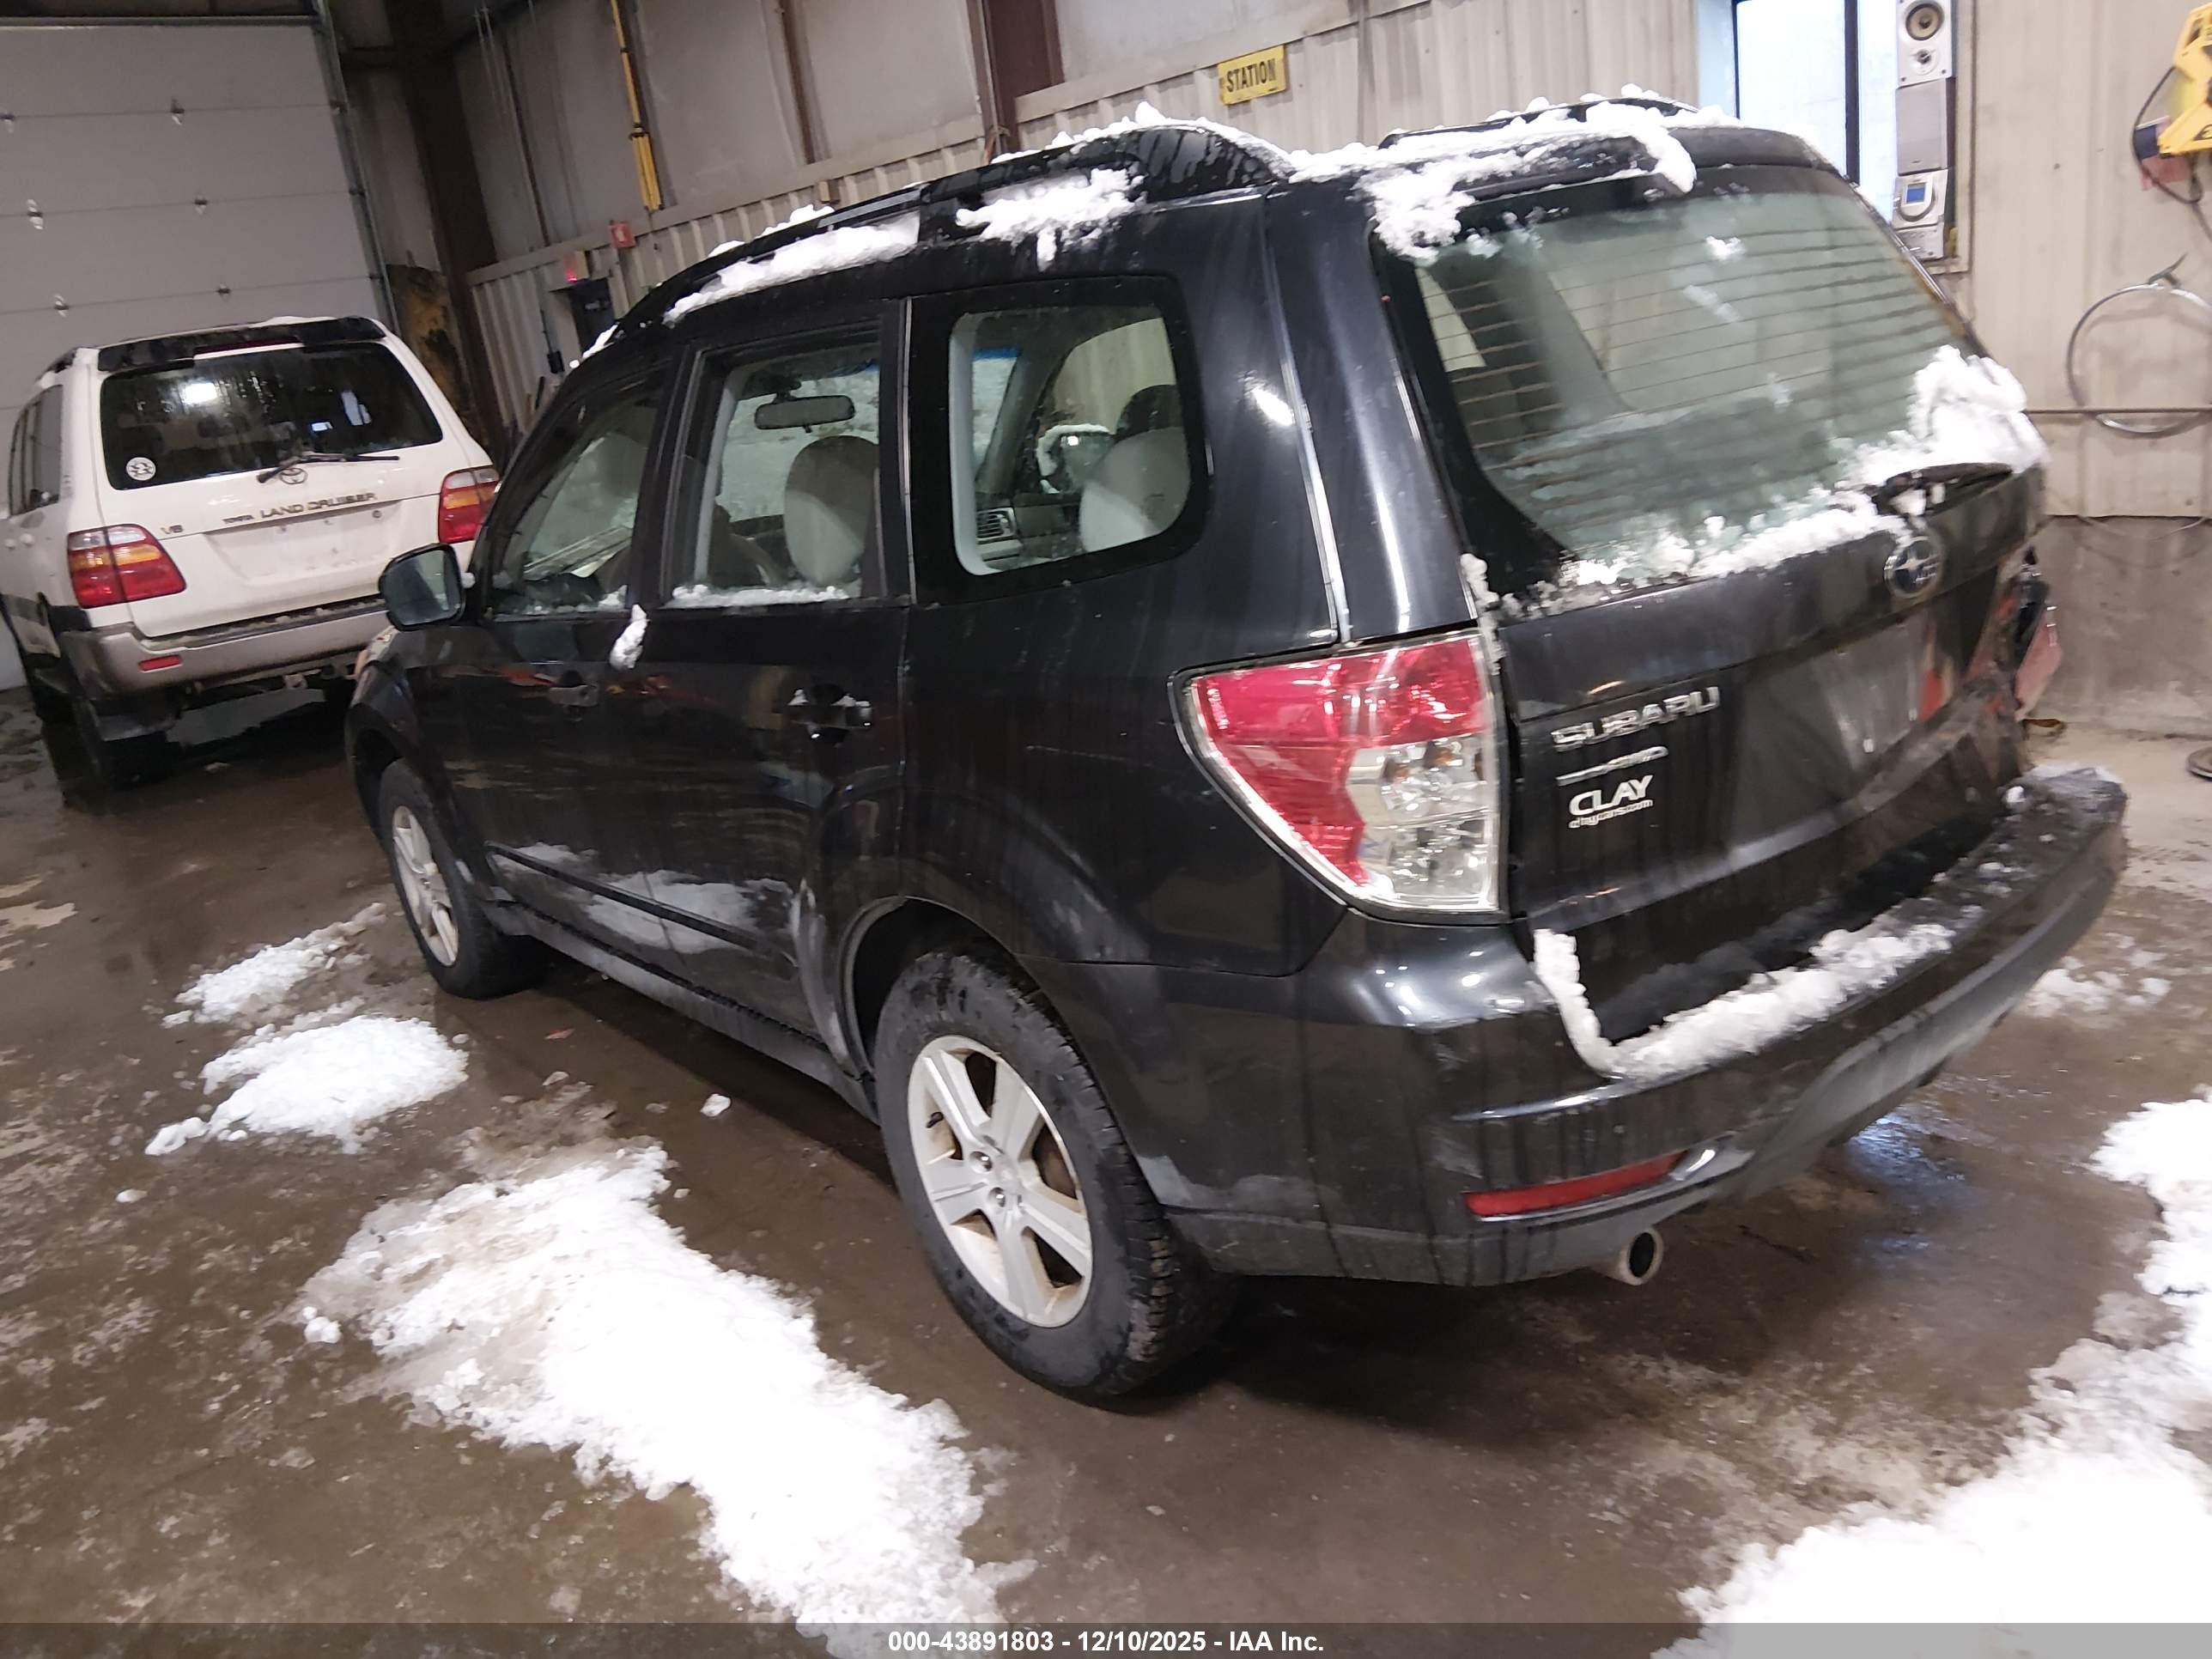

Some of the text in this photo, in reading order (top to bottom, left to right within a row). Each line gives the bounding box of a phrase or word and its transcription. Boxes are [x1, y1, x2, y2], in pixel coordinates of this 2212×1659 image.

[1226, 58, 1276, 93] STATION
[260, 492, 378, 519] LAND CRUISER
[1550, 687, 1721, 752] SUBARU
[1569, 775, 1653, 816] CLAY
